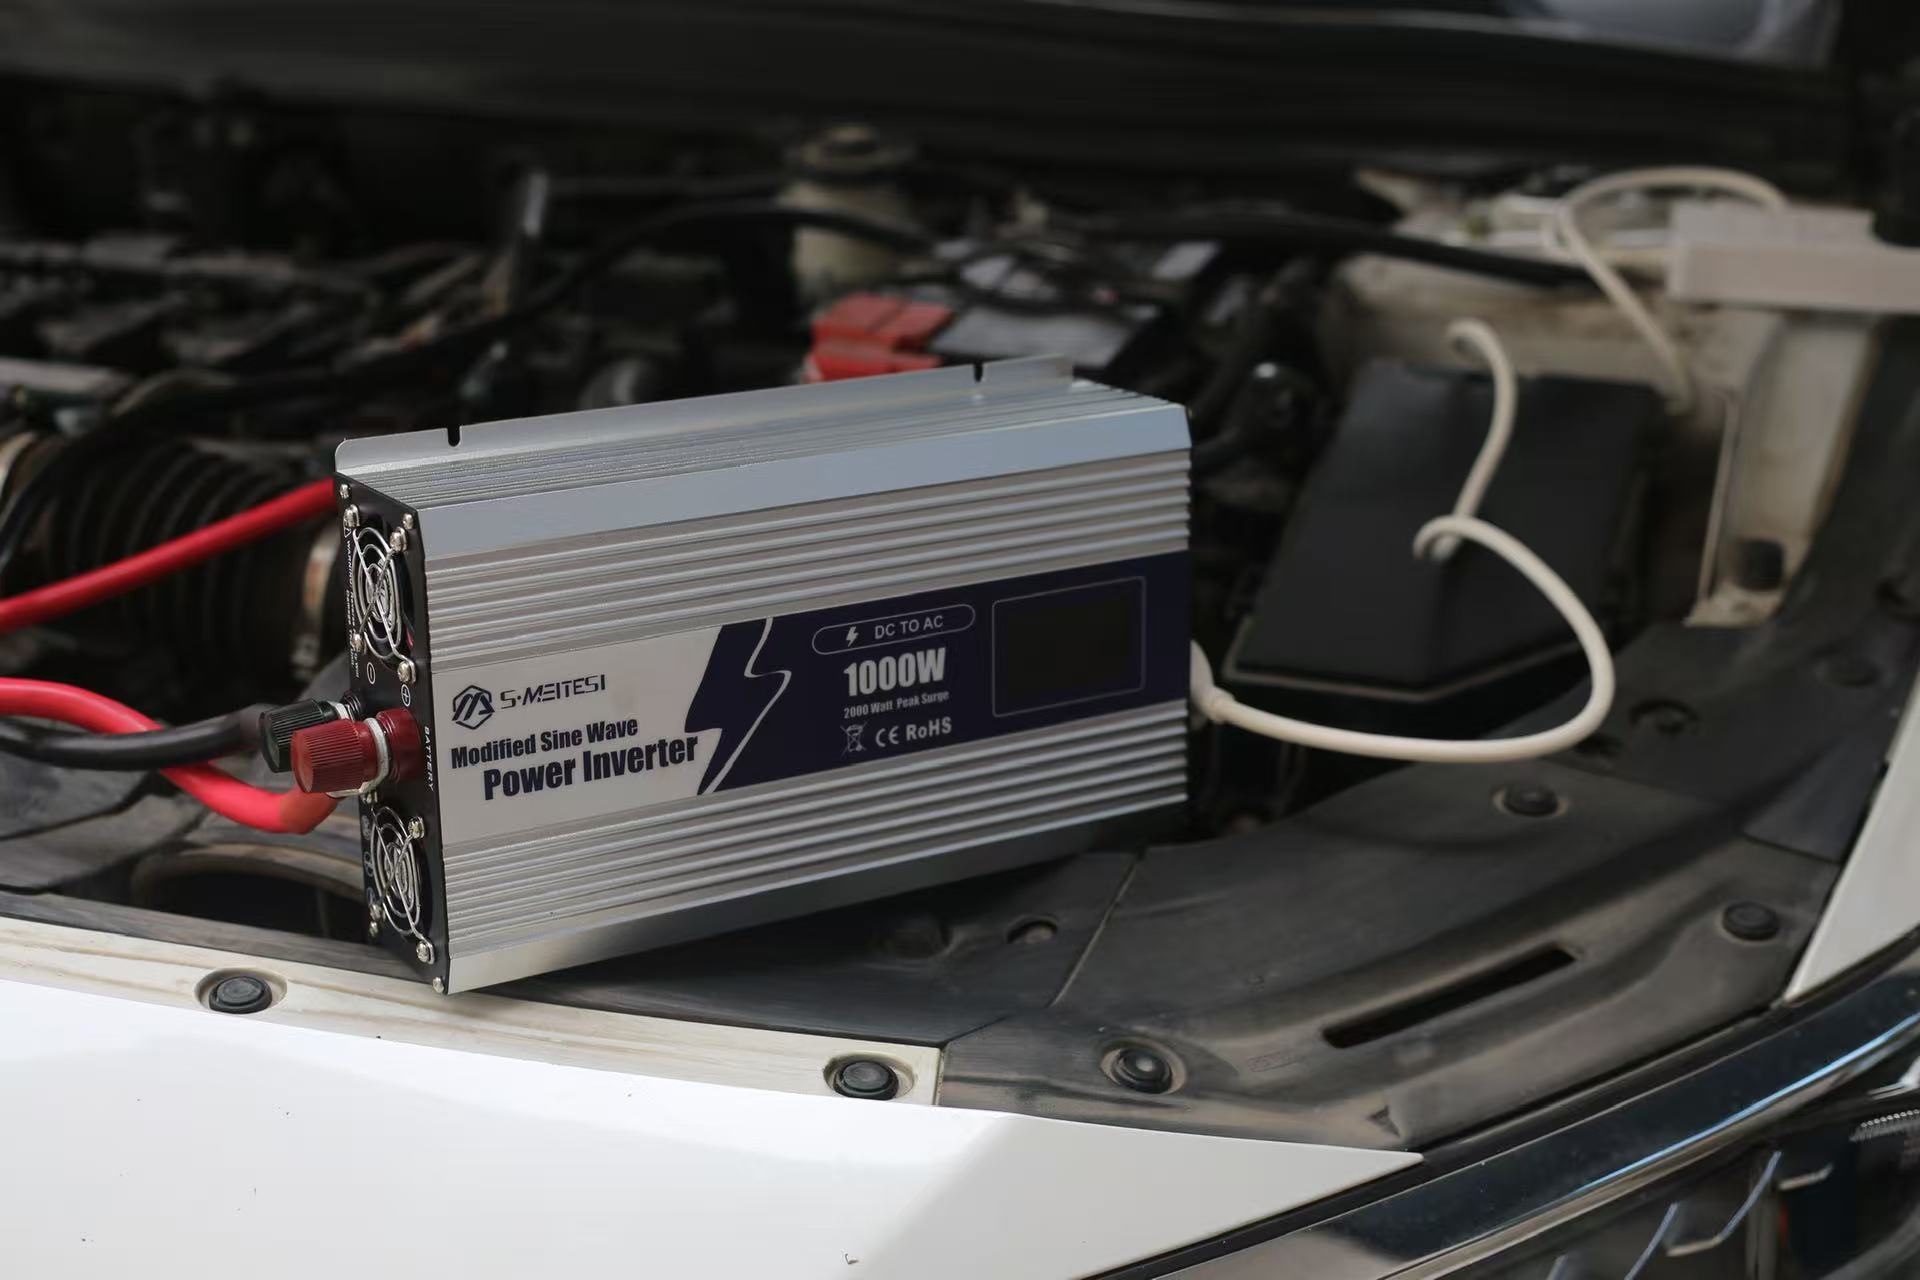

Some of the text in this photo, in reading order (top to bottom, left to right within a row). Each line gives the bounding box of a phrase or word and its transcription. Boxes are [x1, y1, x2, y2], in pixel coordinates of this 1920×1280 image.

[874, 615, 943, 640] DC TO AC
[843, 647, 946, 697] 1000W
[843, 691, 949, 719] 2000 Watt Peak Surge
[906, 716, 952, 741] RoHS
[424, 725, 434, 793] BATTERY
[451, 718, 638, 769] Modified Sine Wave
[484, 736, 699, 801] Power Inverter
